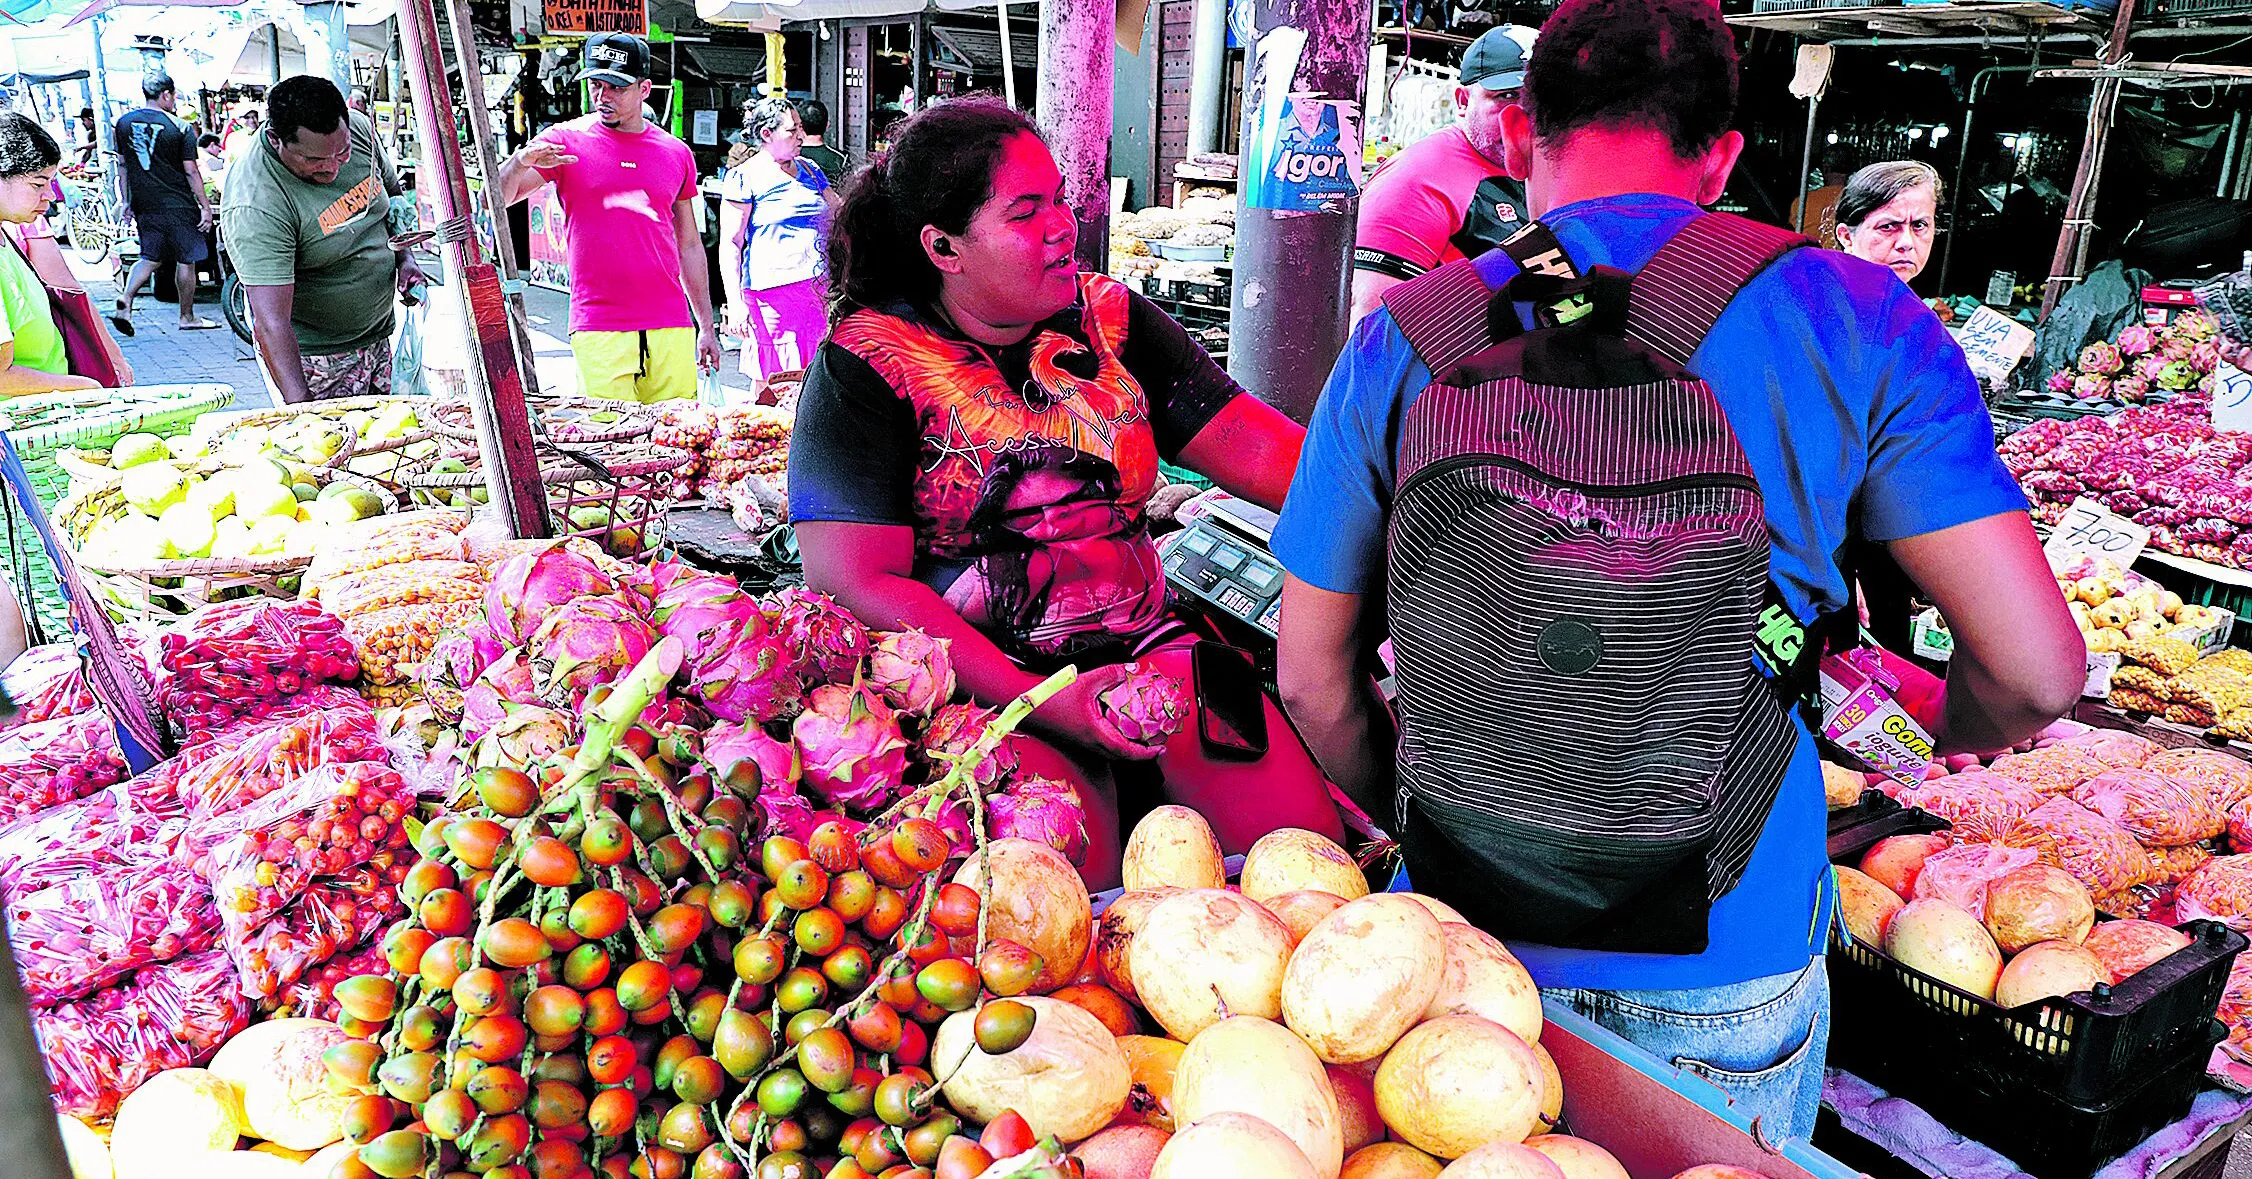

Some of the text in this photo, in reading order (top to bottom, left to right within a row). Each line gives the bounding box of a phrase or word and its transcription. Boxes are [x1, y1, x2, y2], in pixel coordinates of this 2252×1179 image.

[585, 11, 642, 33] MISTURADA
[1274, 149, 1345, 183] Igor
[1971, 311, 2012, 341] UVA
[2065, 508, 2134, 552] 7,00
[1845, 703, 1867, 724] 30
[1863, 731, 1922, 771] iogurte
